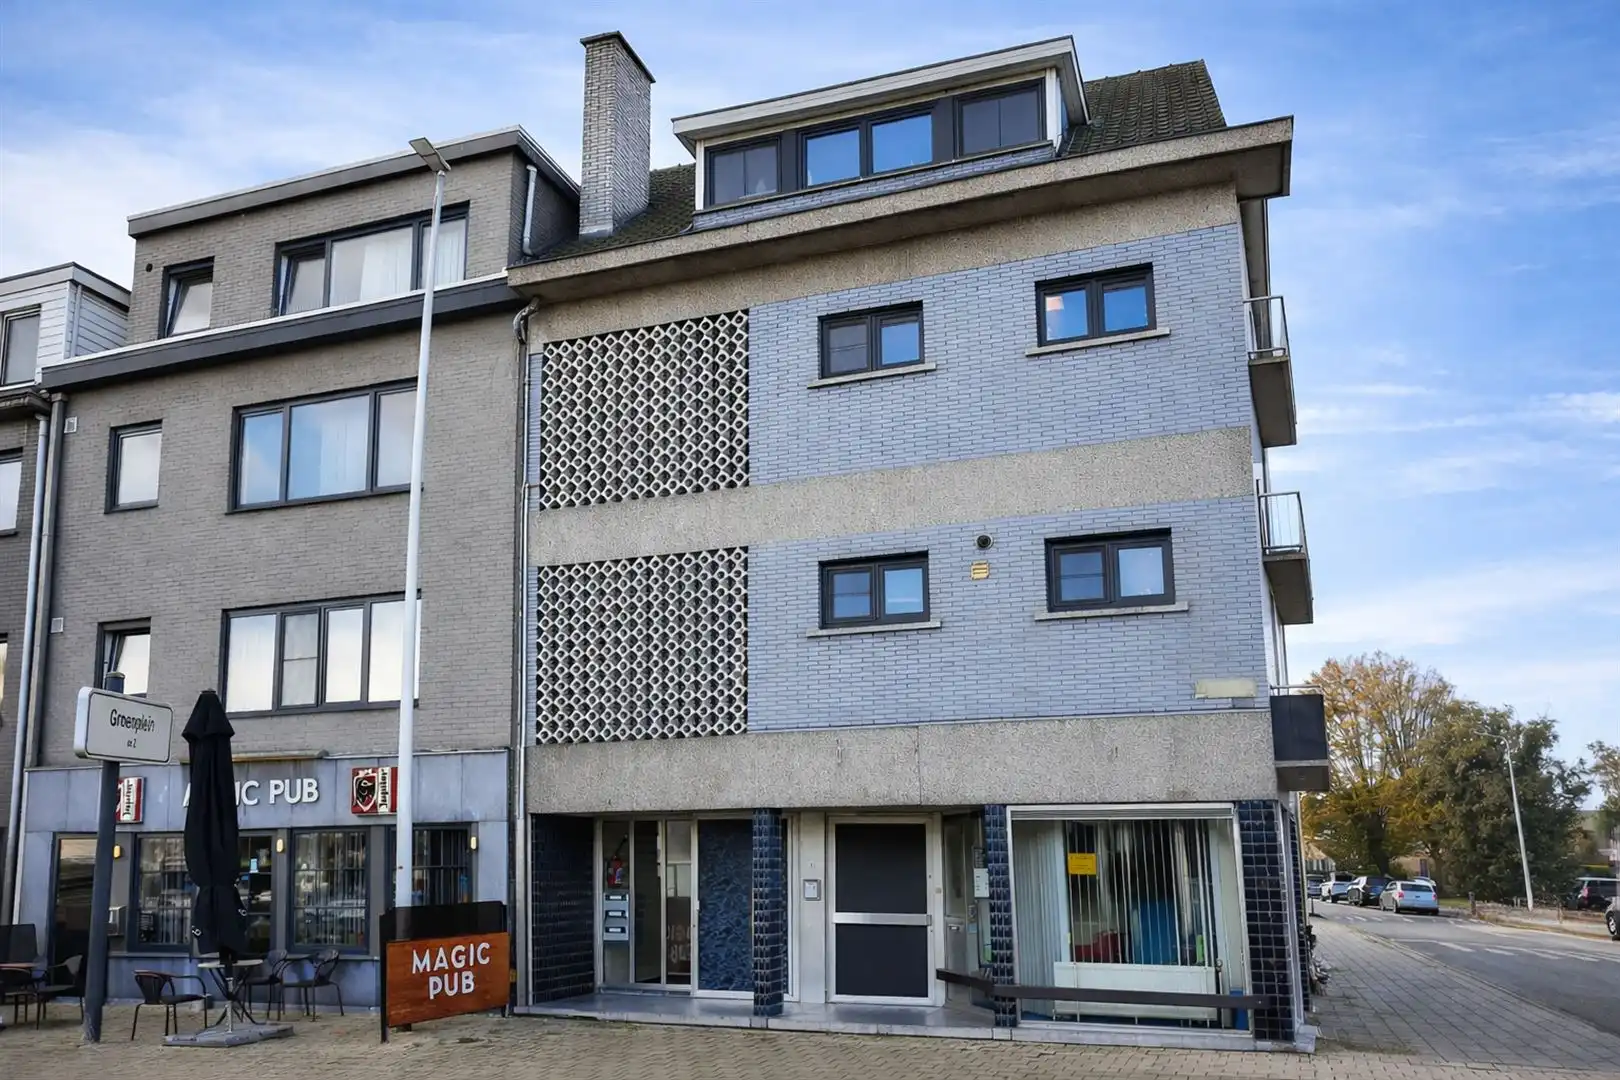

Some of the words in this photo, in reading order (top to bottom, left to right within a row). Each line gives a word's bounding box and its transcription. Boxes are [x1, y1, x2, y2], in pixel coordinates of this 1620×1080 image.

[268, 778, 319, 804] PUB
[412, 942, 490, 974] MAGIC
[428, 970, 475, 1000] PUB
